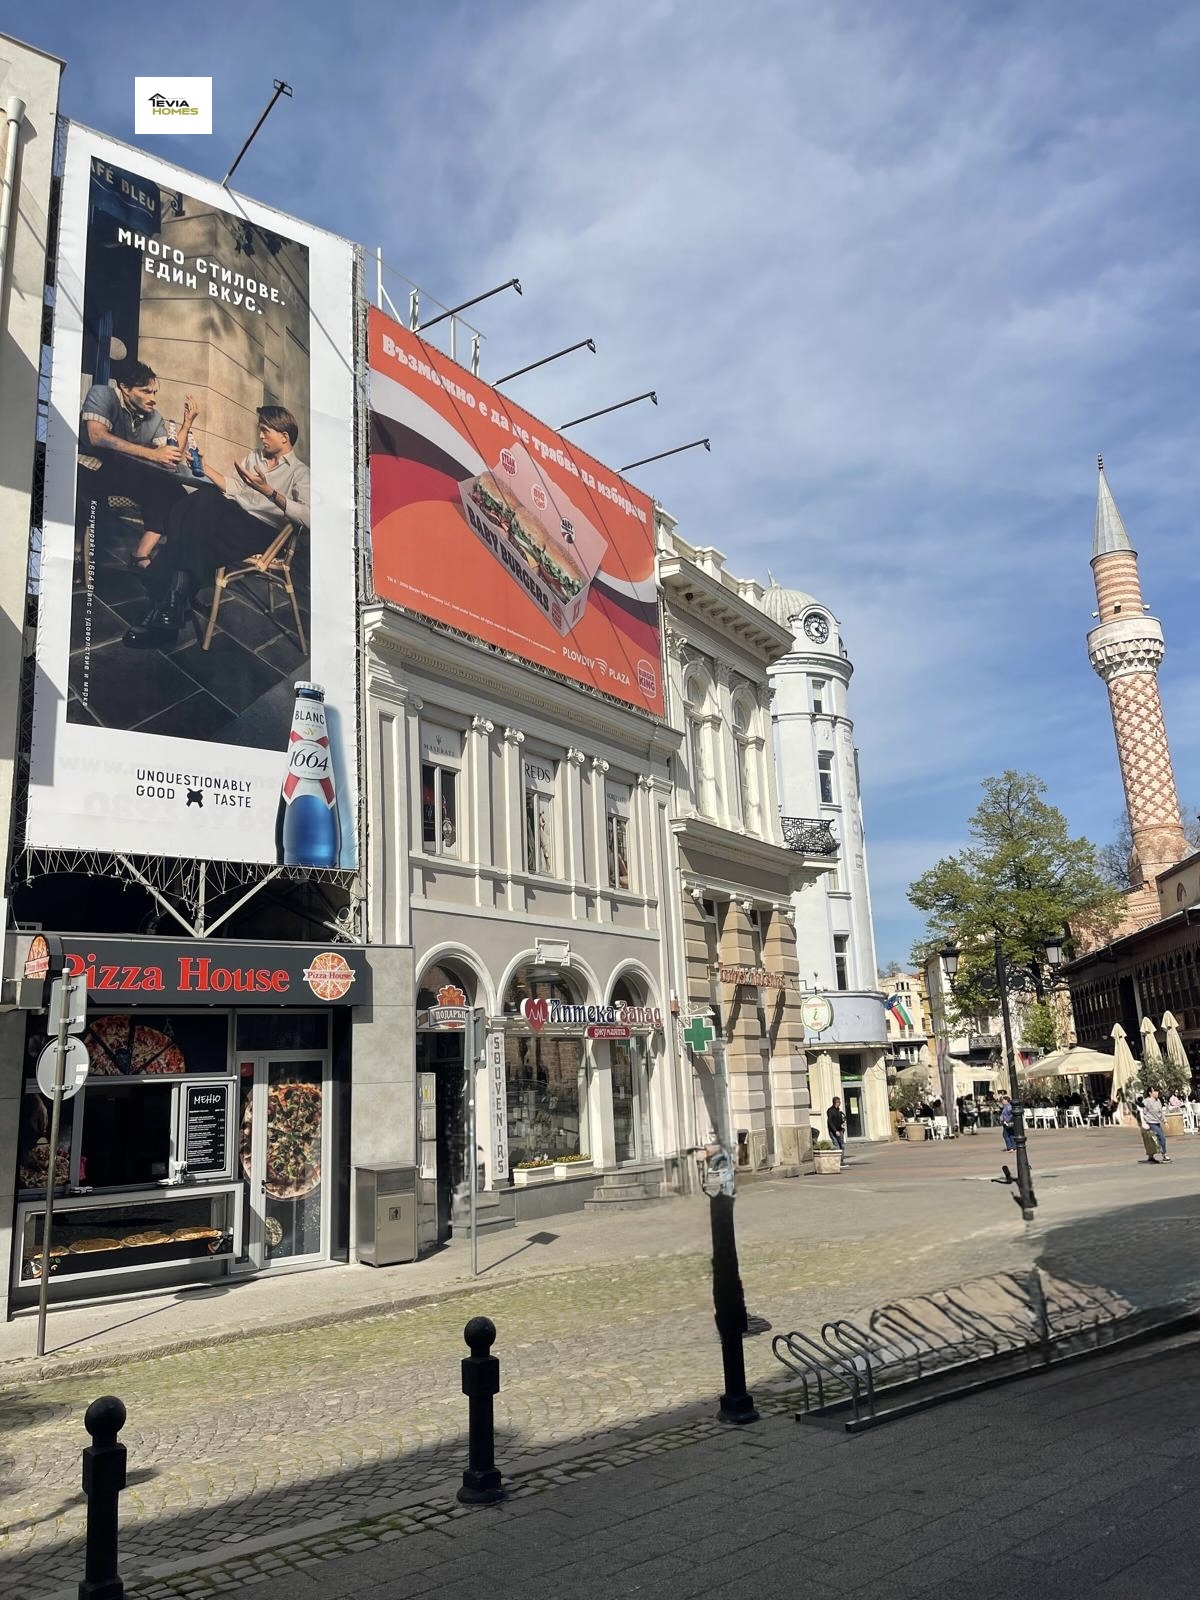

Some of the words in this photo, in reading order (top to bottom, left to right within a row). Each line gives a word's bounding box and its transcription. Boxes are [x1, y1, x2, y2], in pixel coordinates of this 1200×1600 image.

[121, 179, 155, 212] BLEU
[118, 227, 185, 265] МНОГО
[196, 258, 287, 306] СТИЛОВЕ.
[145, 258, 197, 290] ЕДИН
[208, 281, 263, 315] ВКУС.
[382, 333, 476, 409] Възможно
[478, 401, 488, 417] е
[491, 408, 510, 431] да
[511, 423, 530, 444] не
[531, 436, 579, 478] трябва
[581, 469, 596, 489] да
[597, 481, 647, 524] избираш
[88, 500, 97, 557] Консумирайте
[467, 503, 499, 554] BABY
[500, 541, 550, 612] BURGERS
[87, 560, 95, 582] 1664
[86, 584, 94, 607] Blanc
[84, 617, 92, 670] удоволствие
[562, 646, 595, 669] PLOVDIV
[609, 669, 631, 686] PLAZA
[638, 668, 655, 681] BURGER
[639, 677, 656, 692] KING
[294, 710, 325, 725] BLANC
[289, 748, 329, 772] 1664
[136, 768, 252, 792] UNQUESTIONABLY
[525, 763, 551, 784] REDS
[136, 785, 175, 800] GOOD
[213, 793, 252, 808] TASTE
[64, 953, 165, 991] Pizza
[177, 956, 290, 993] House
[307, 971, 327, 979] Pizza
[329, 971, 352, 980] House
[435, 1009, 466, 1021] ПОДАРЪЦ
[549, 999, 617, 1024] Аптека
[616, 1000, 662, 1028] Запад
[193, 1093, 221, 1105] МЕНЮ
[493, 1036, 504, 1174] SOUVENIRS
